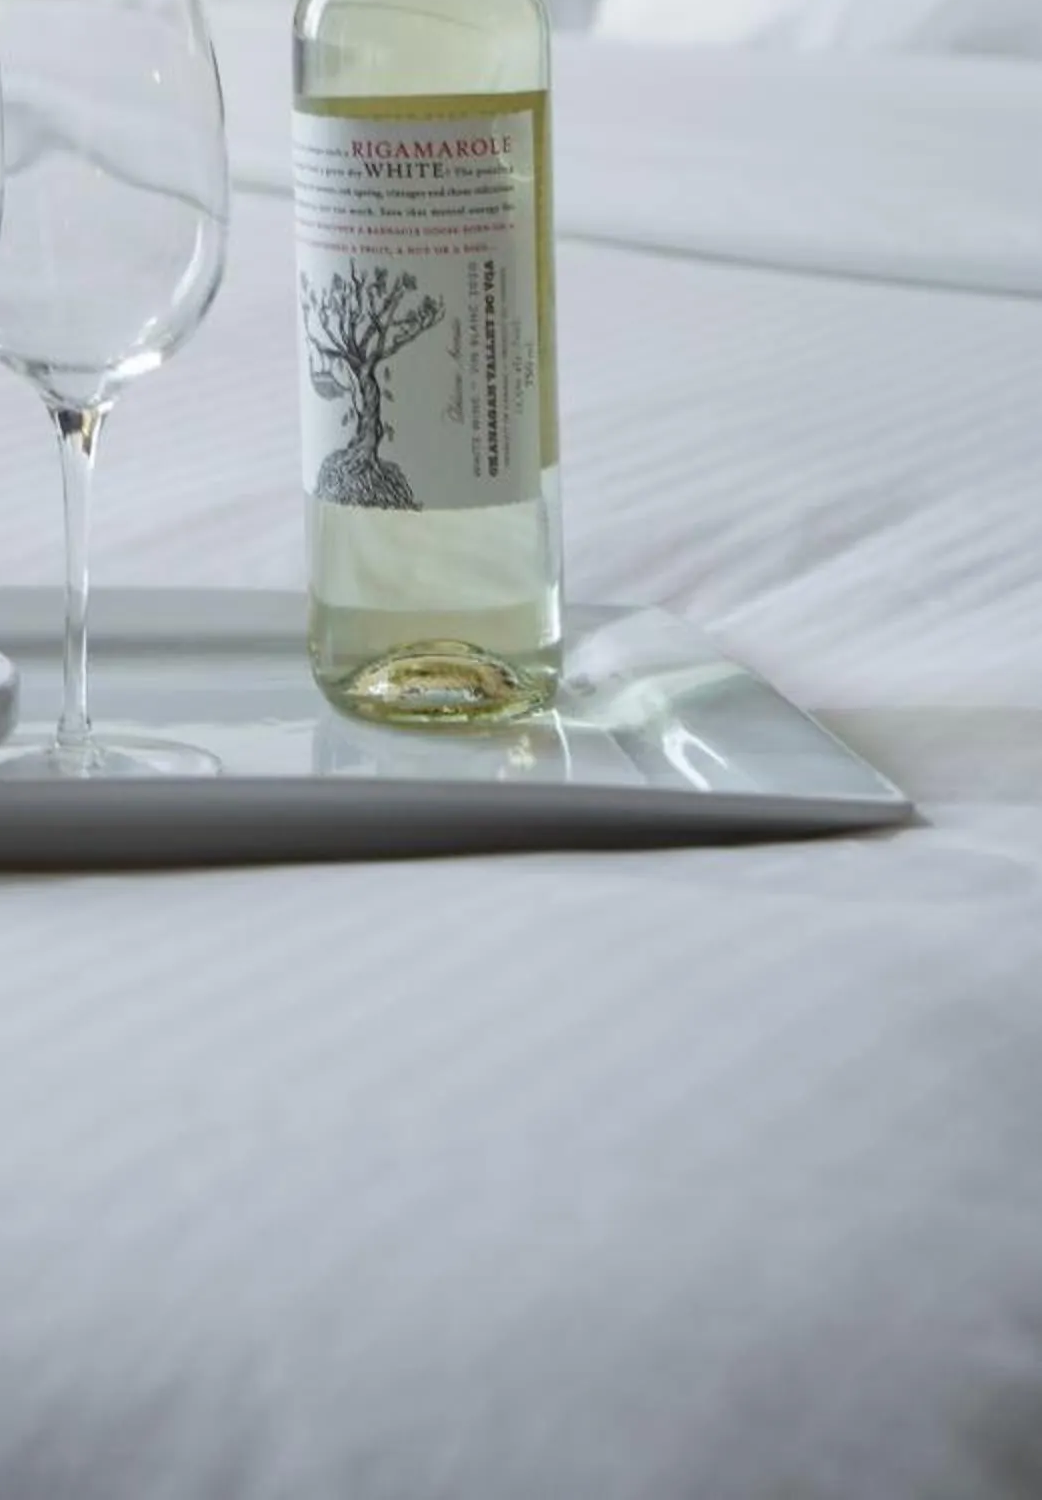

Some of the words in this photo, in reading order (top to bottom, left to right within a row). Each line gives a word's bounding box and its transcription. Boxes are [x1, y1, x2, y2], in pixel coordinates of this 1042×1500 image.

[351, 135, 512, 159] RIGAMAROLE
[484, 319, 498, 382] VALLEY
[485, 383, 500, 478] OKANAGAN
